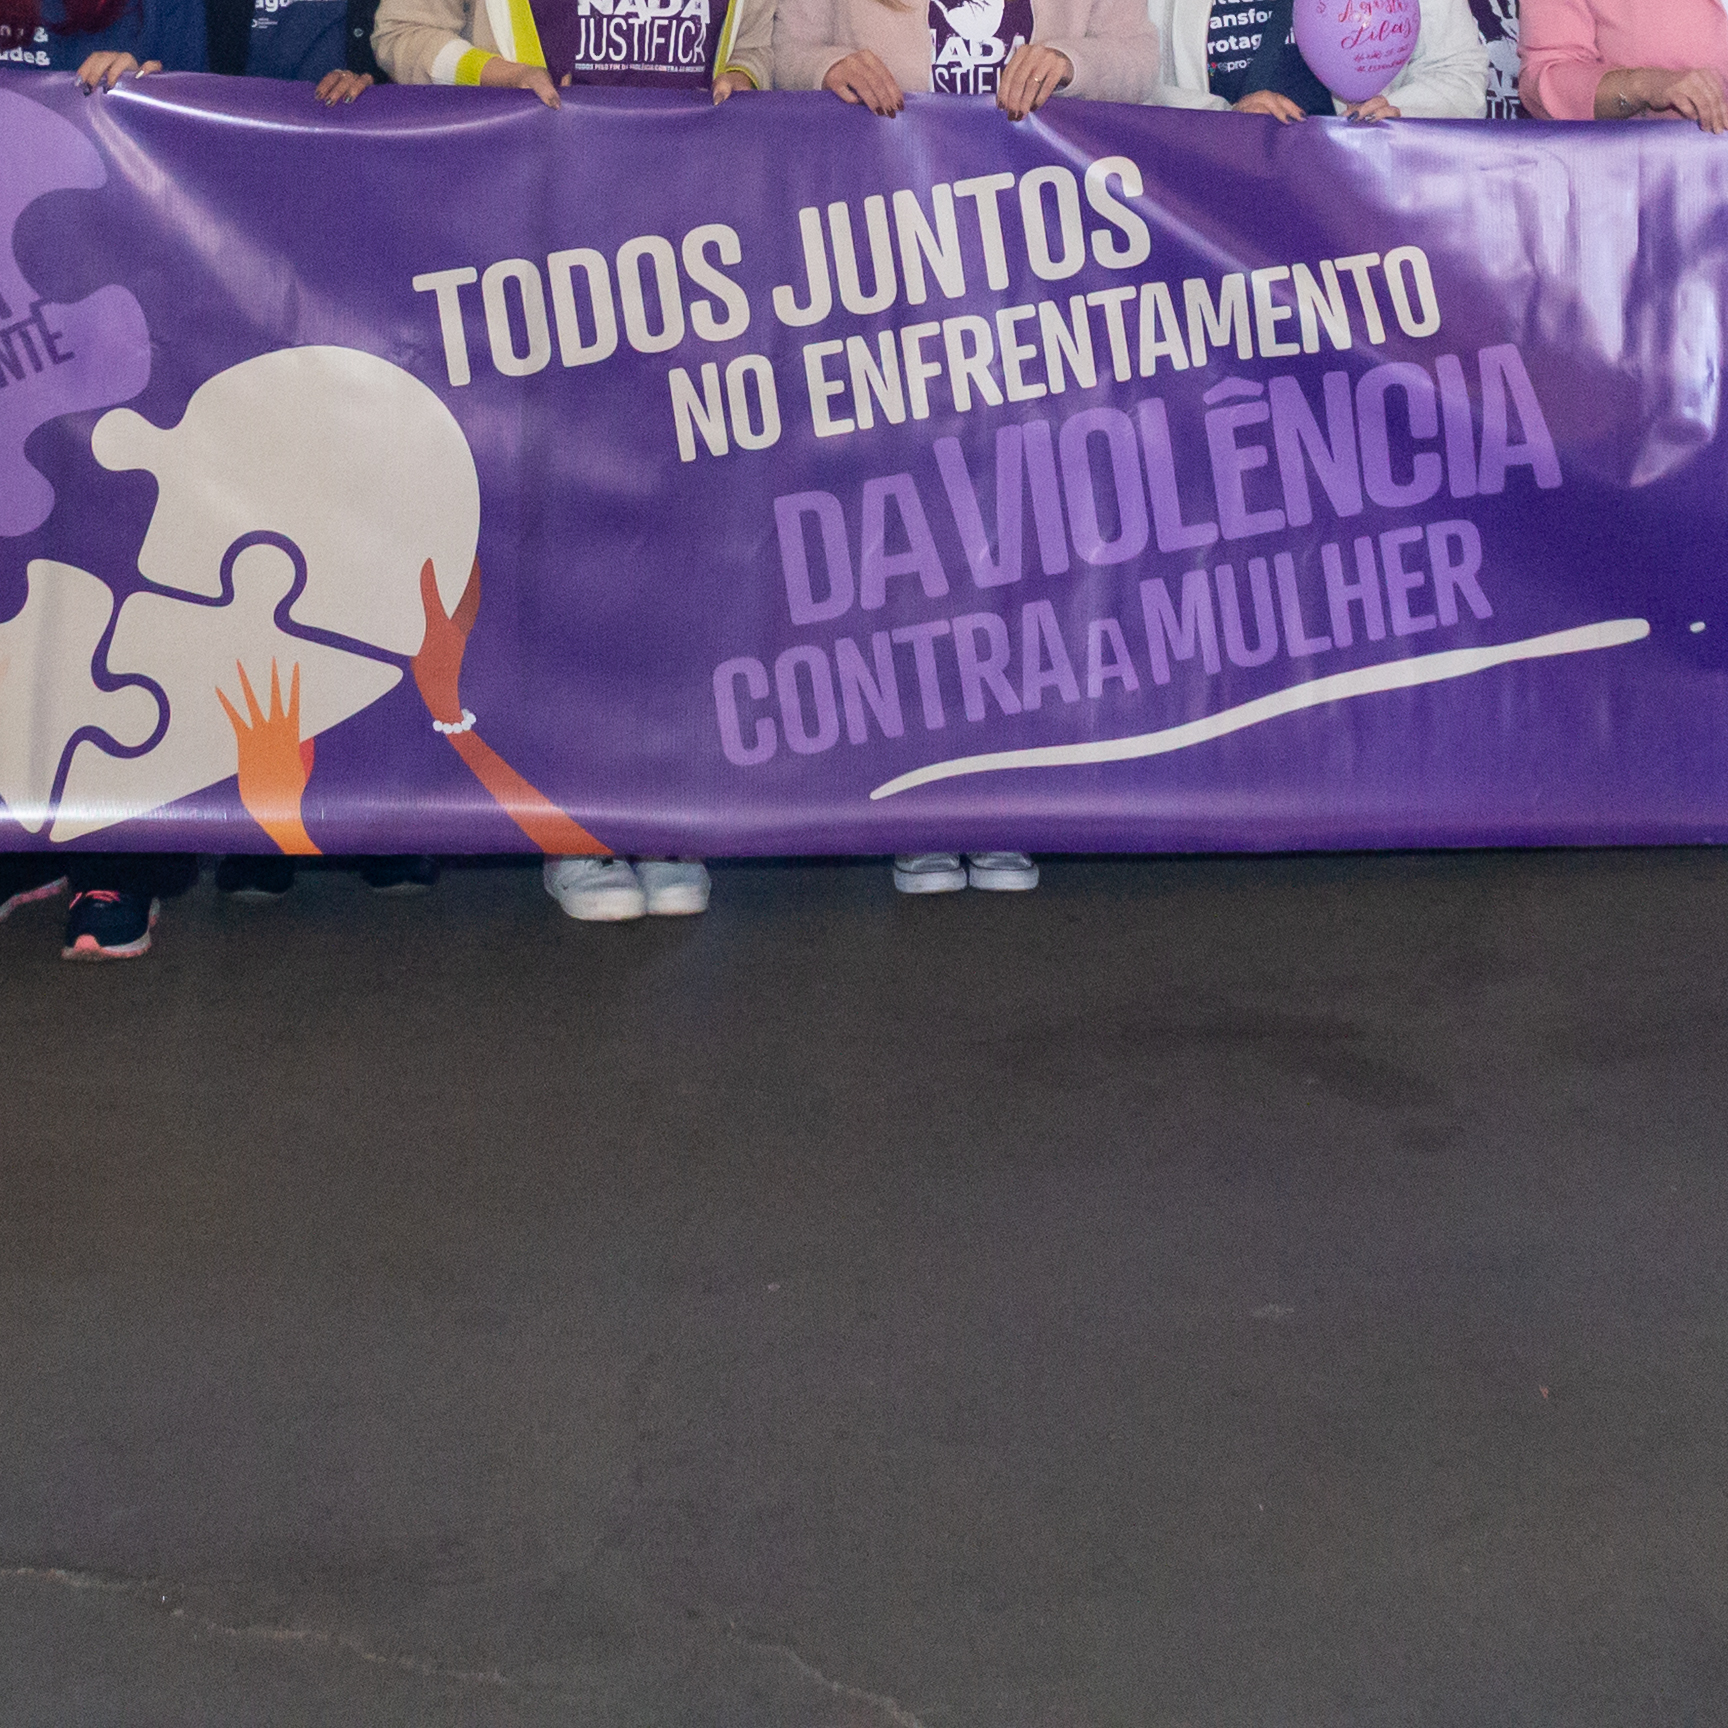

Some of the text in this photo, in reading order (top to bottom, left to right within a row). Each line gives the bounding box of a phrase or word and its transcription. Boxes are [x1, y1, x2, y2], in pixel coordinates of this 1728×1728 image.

[574, 17, 707, 65] JUSTIFICA
[412, 154, 1153, 387] TODOS JUNTOS
[668, 245, 1442, 463] NO ENFRENTAMENTO
[773, 342, 1564, 627] DA VIOLÊNCIA
[712, 518, 1494, 767] CONTRA A MULHER
